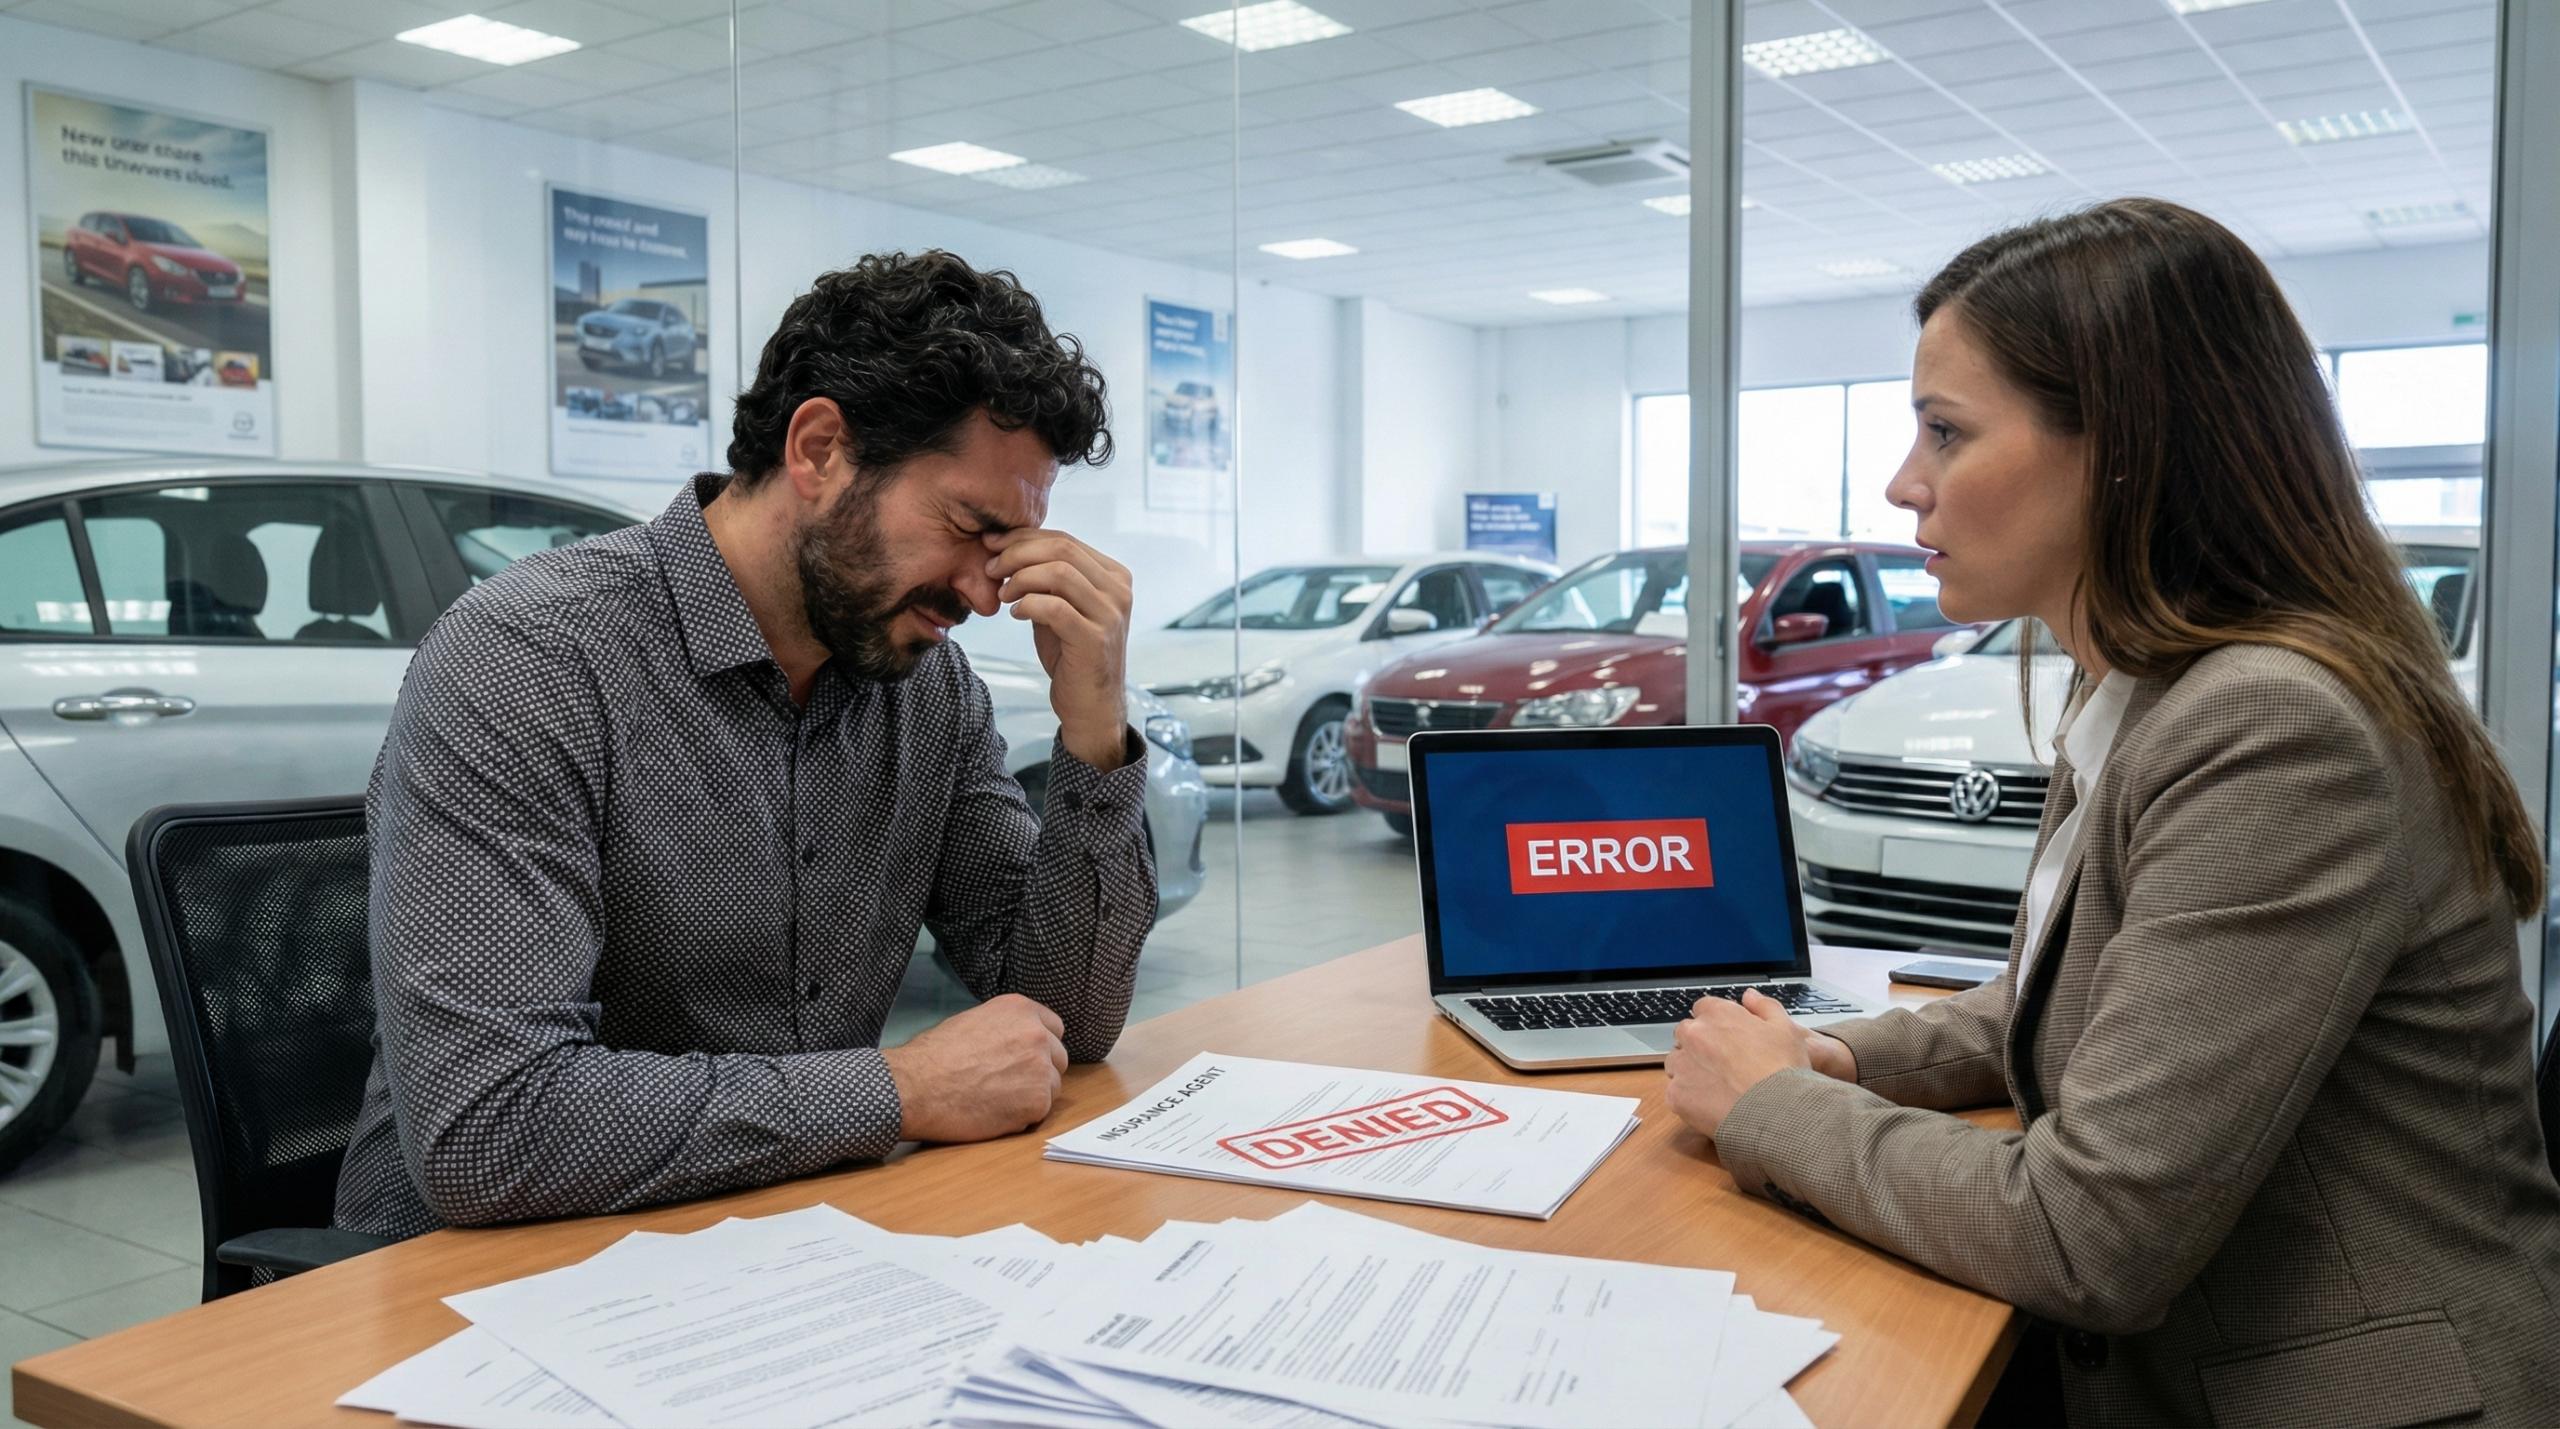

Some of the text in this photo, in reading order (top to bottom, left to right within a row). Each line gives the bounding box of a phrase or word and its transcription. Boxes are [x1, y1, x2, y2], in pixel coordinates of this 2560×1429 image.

[61, 125, 107, 147] New
[1527, 835, 1695, 877] ERROR
[1096, 1095, 1185, 1142] INSURANCE
[1177, 1065, 1226, 1098] AGENT
[1249, 1099, 1473, 1160] DENIED
